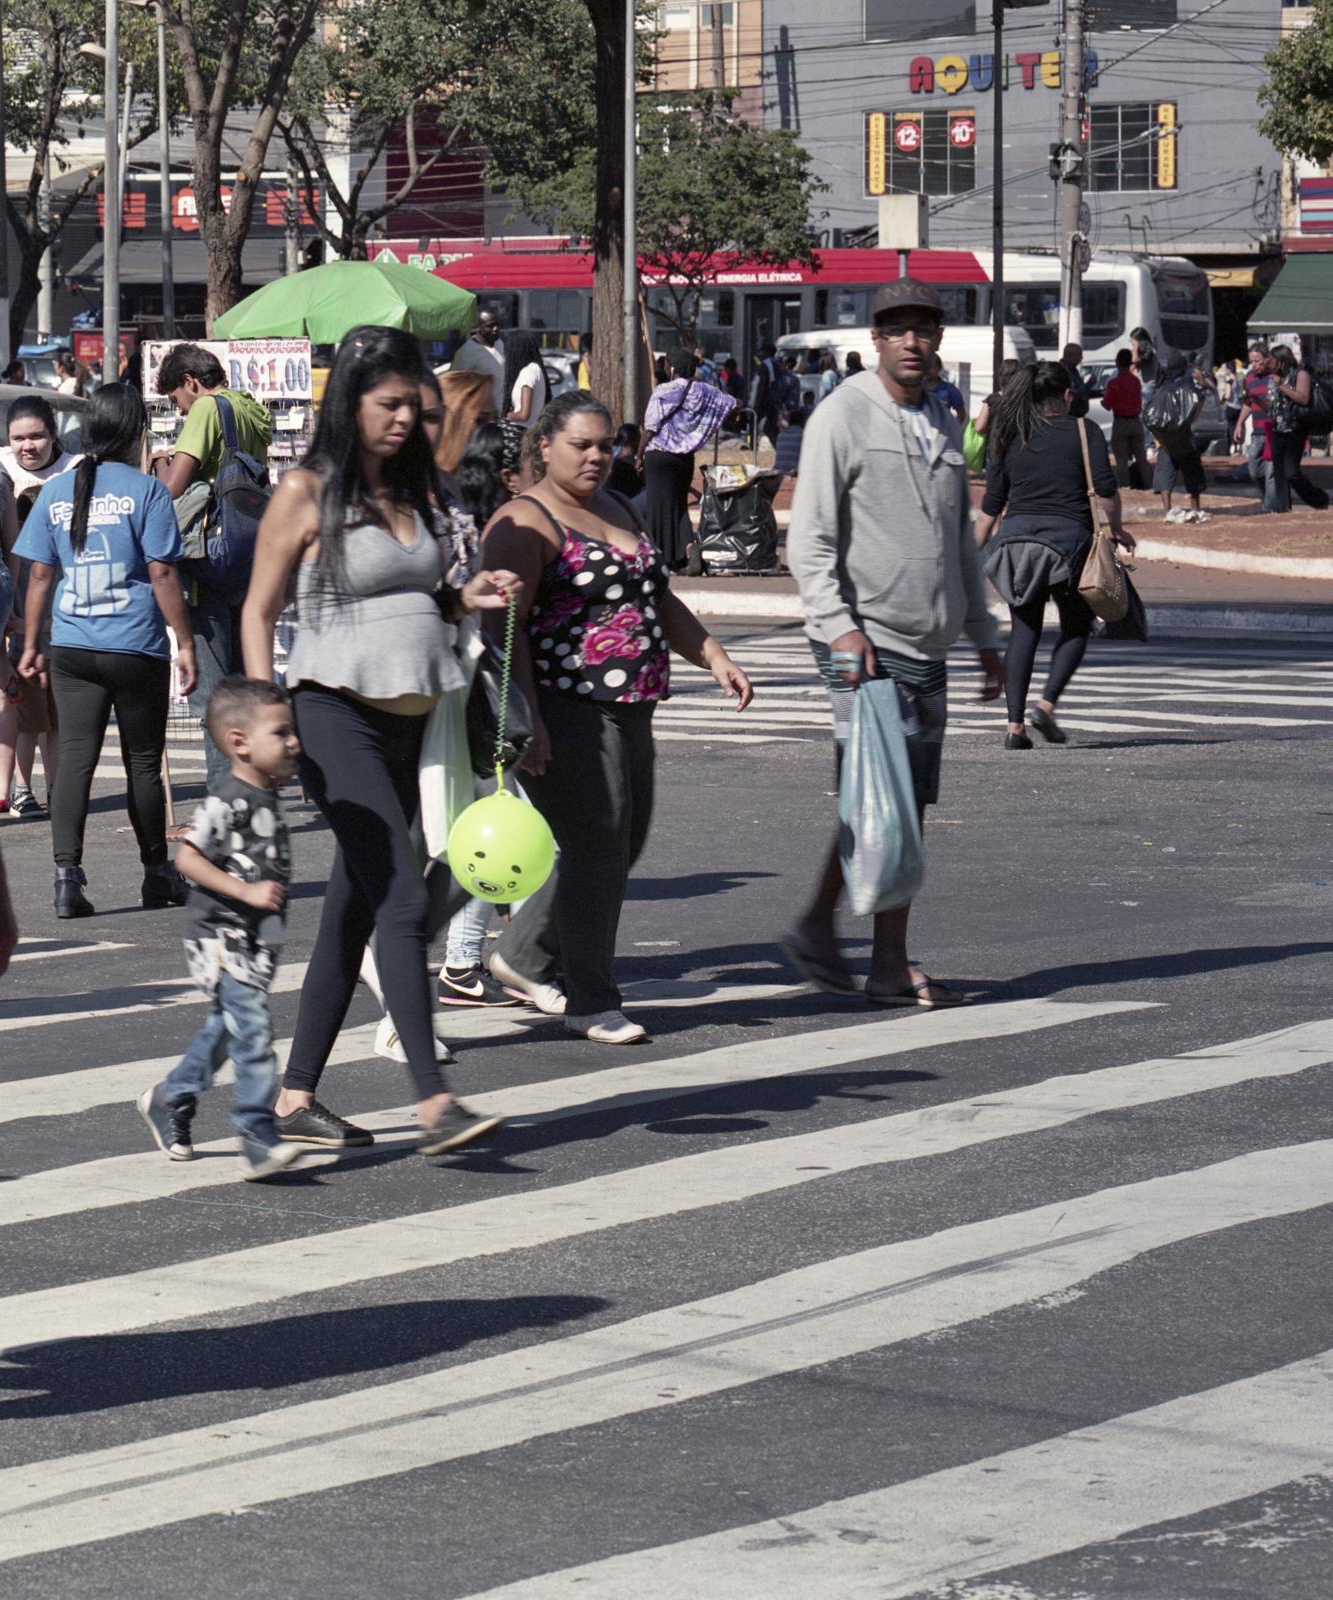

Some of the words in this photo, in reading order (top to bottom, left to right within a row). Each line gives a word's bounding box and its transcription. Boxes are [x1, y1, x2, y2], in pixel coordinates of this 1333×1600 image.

[717, 273, 756, 284] ENERGIA
[758, 271, 803, 283] ELÉTRICA
[885, 284, 931, 299] NYC
